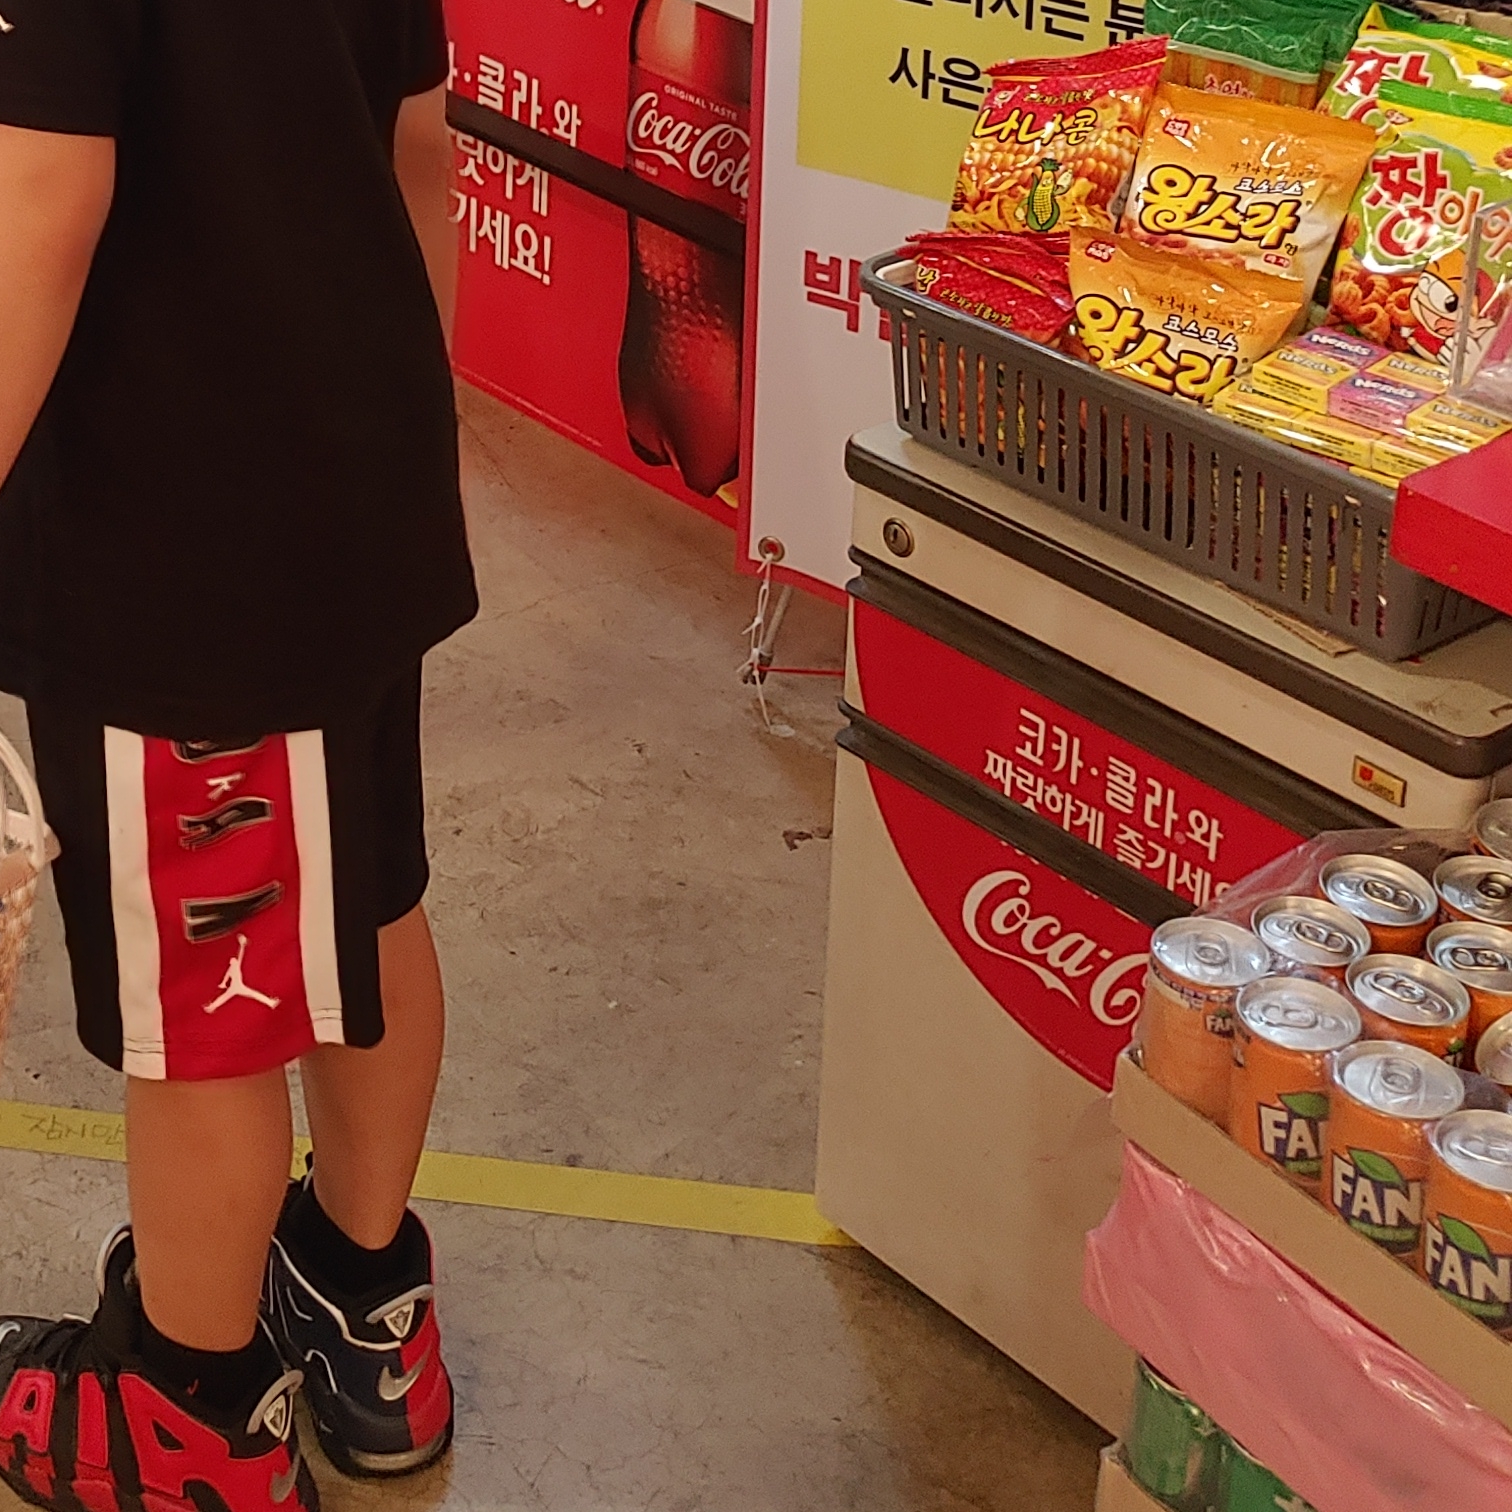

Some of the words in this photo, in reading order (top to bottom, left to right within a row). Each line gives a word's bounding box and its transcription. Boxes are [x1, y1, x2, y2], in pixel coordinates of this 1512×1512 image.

[663, 84, 707, 110] ORIGINAL
[888, 47, 992, 112] 사은
[972, 107, 1099, 149] 나나콘
[1136, 163, 1301, 250] 왕소라
[1074, 293, 1238, 404] 왕소라
[1163, 313, 1239, 353] 코스모스
[1185, 809, 1224, 862] 와
